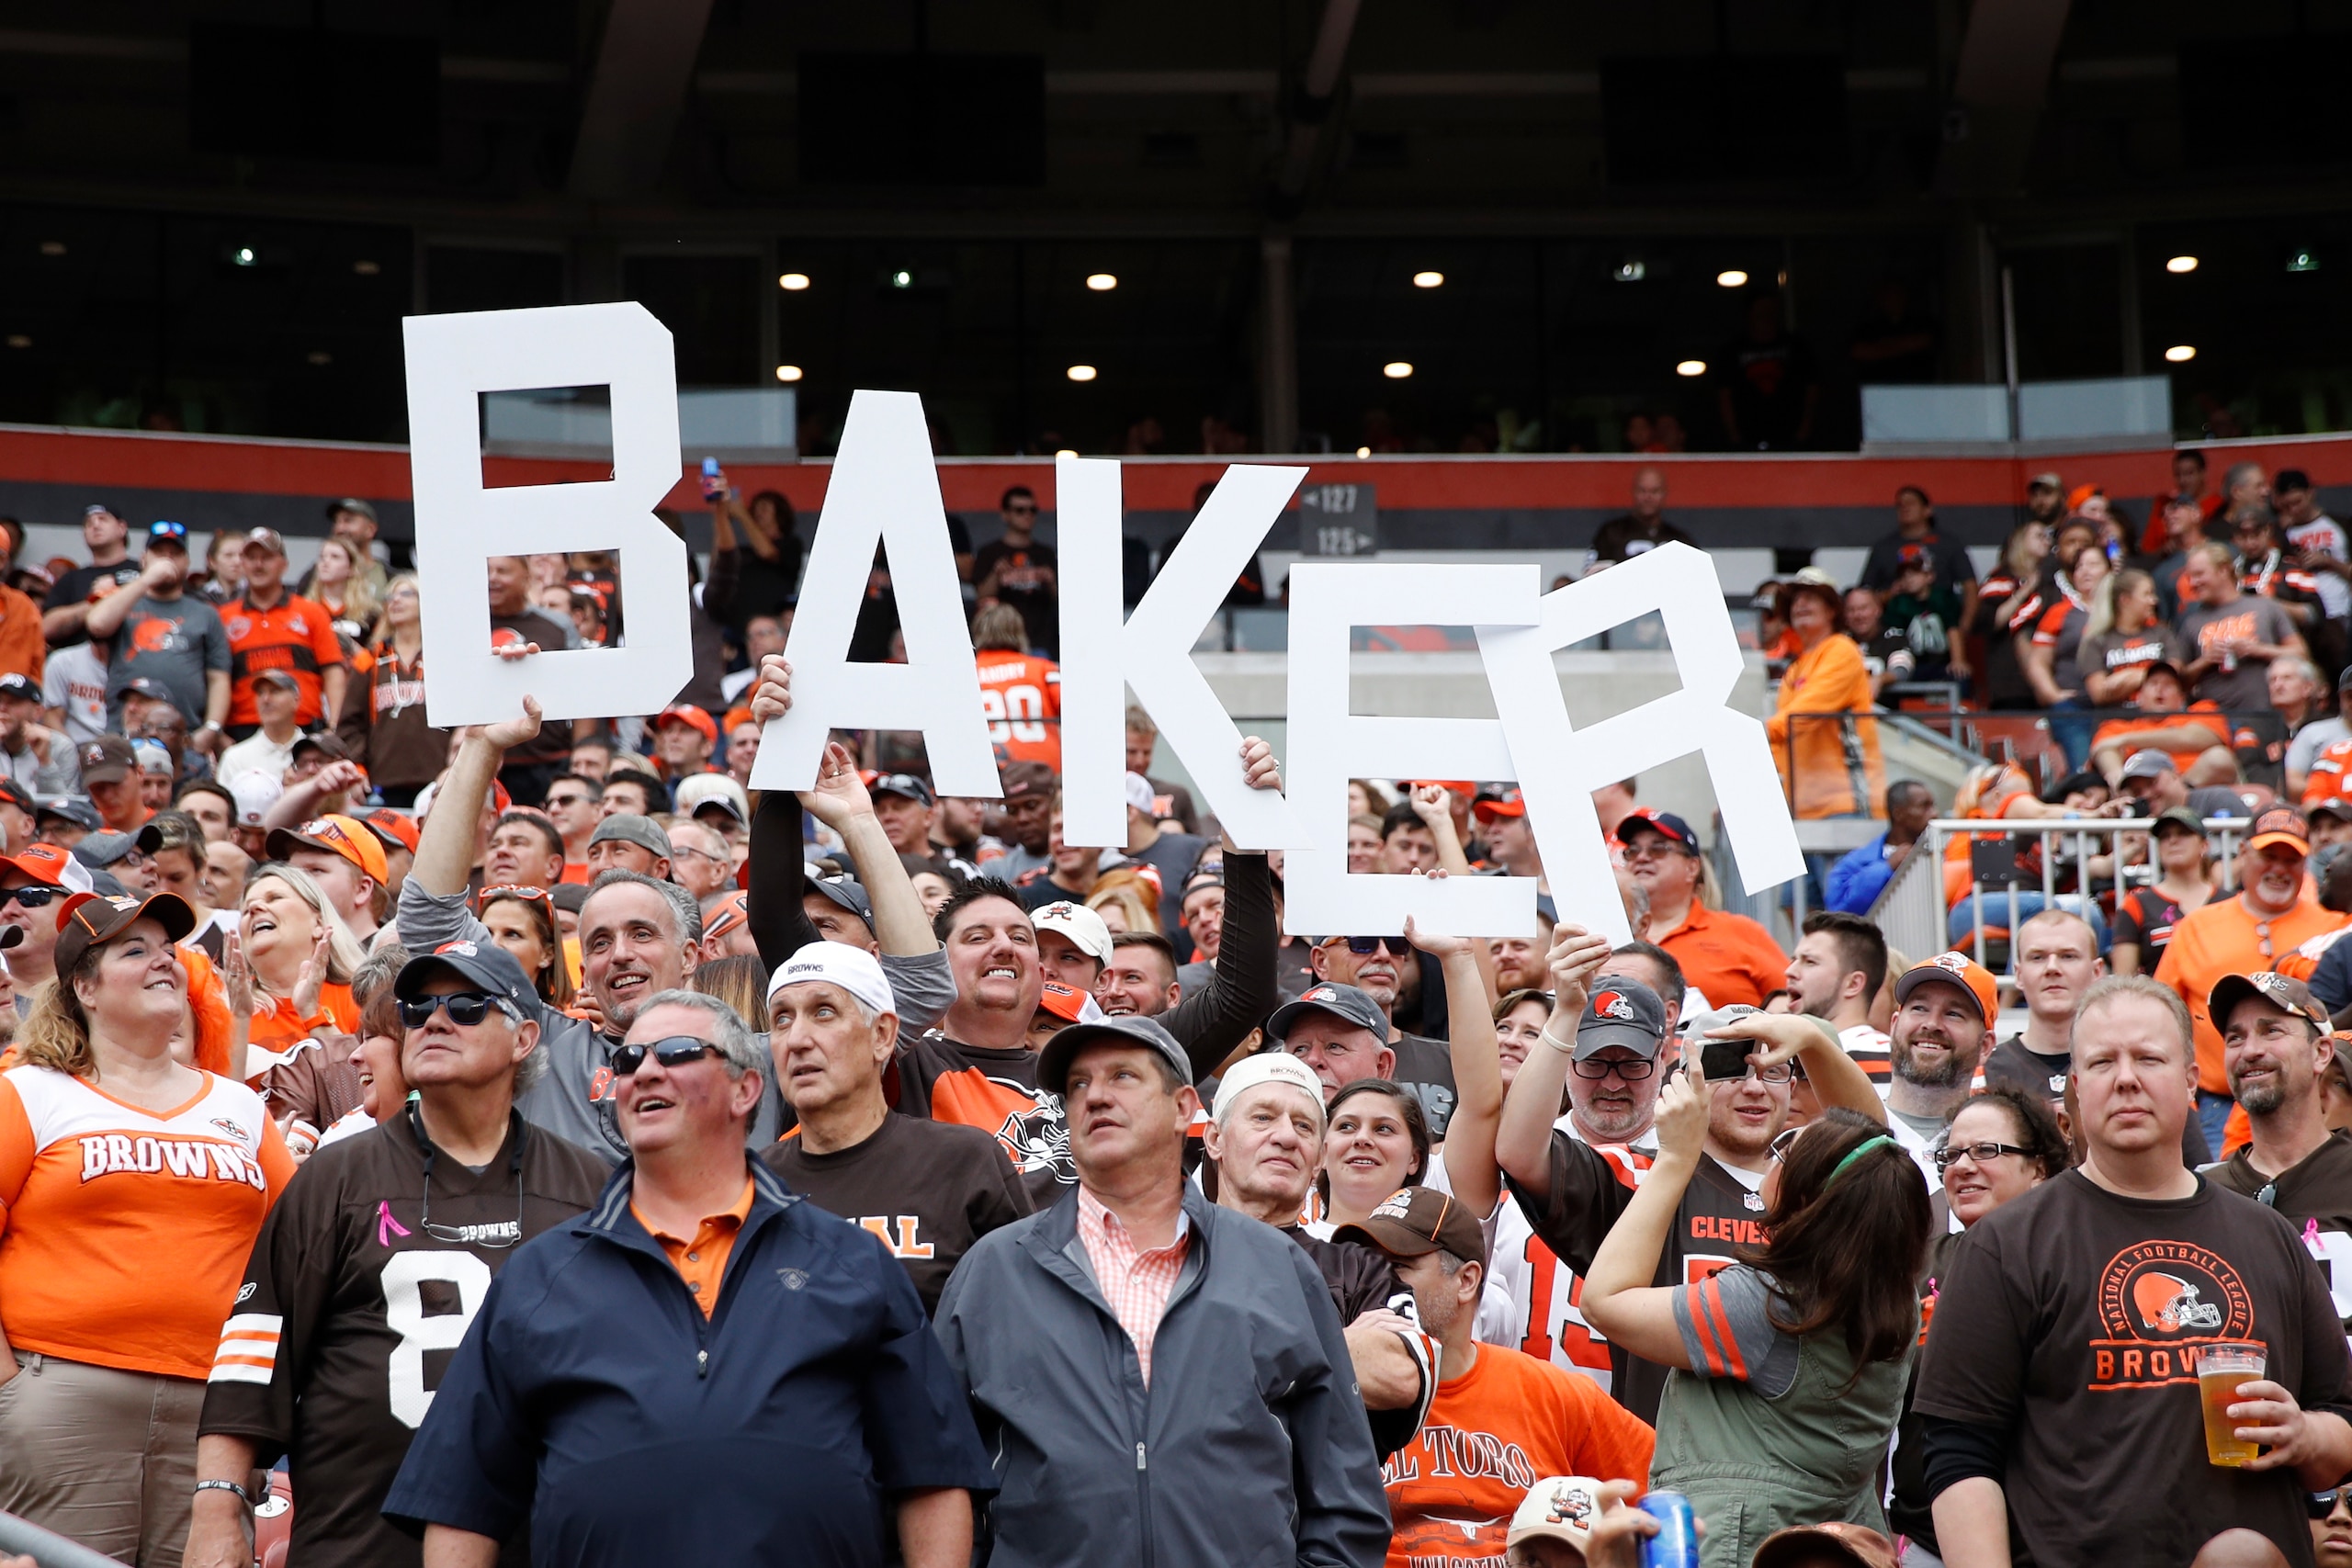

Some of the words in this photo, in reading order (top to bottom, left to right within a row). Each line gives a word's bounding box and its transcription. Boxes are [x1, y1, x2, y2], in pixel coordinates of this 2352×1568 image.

[1322, 484, 1357, 513] 127
[1317, 527, 1356, 555] 125
[402, 300, 1808, 944] BAKER
[787, 964, 824, 975] BROWNS
[1270, 1067, 1306, 1081] BROWNS
[79, 1134, 266, 1193] BROWNS
[2106, 1259, 2132, 1332] NATIONAL
[2132, 1246, 2217, 1270] FOOTBALL
[2220, 1272, 2247, 1331] LEAGUE
[379, 1248, 492, 1430] 8
[1423, 1425, 1535, 1490] TORO
